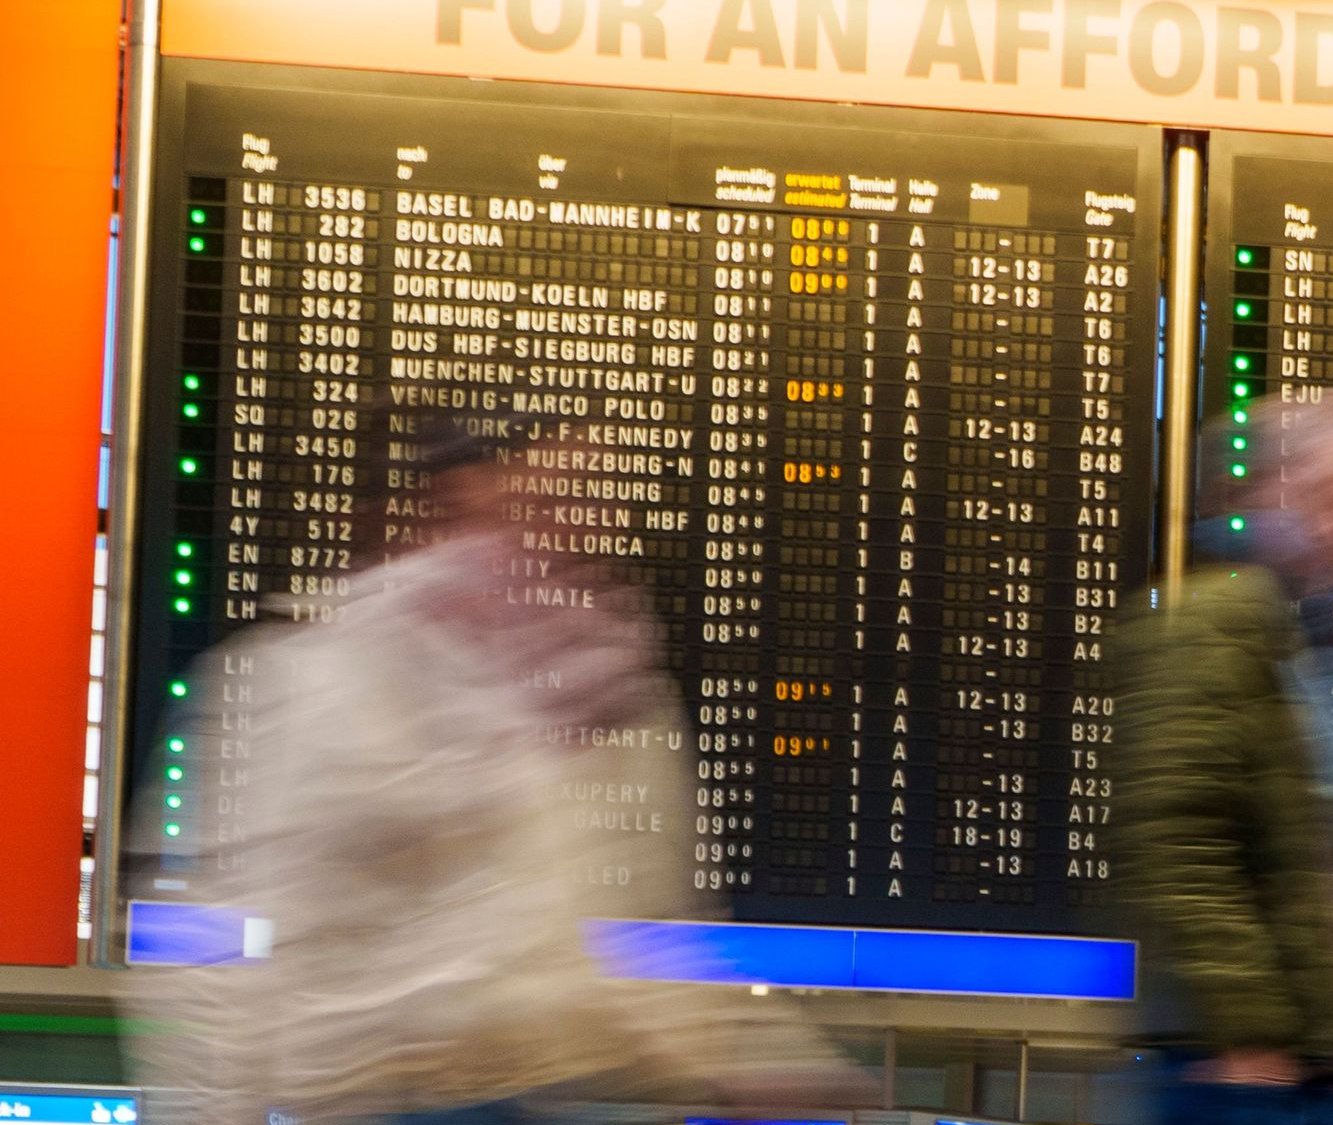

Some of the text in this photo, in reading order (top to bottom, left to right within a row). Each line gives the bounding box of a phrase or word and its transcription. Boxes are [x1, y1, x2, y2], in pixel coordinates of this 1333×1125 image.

[704, 0, 866, 74] AN
[244, 183, 700, 234] LH 3536 BASEL BAD-MANNHEIM-K
[242, 238, 471, 272] LH 1058 NIZZA
[243, 210, 1127, 286] LH 282 BOLOGNA 0810 1 A 12-13 A26
[1286, 251, 1312, 271] SN
[241, 266, 666, 311] LH 3602 DORTMUND-KOELN HBF
[1285, 277, 1312, 297] LH
[302, 297, 697, 343] 3642 HAMBURG-MUENSTER-OSN
[300, 325, 693, 367] 3500 DUS HBF-SIEGBURG HBF
[299, 352, 695, 397] 3402 MUENCHEN-STUTTGART-U
[1282, 358, 1307, 377] DE
[314, 381, 664, 420] 324 VENEDIG-MARCO POLO
[1282, 384, 1322, 404] EJU
